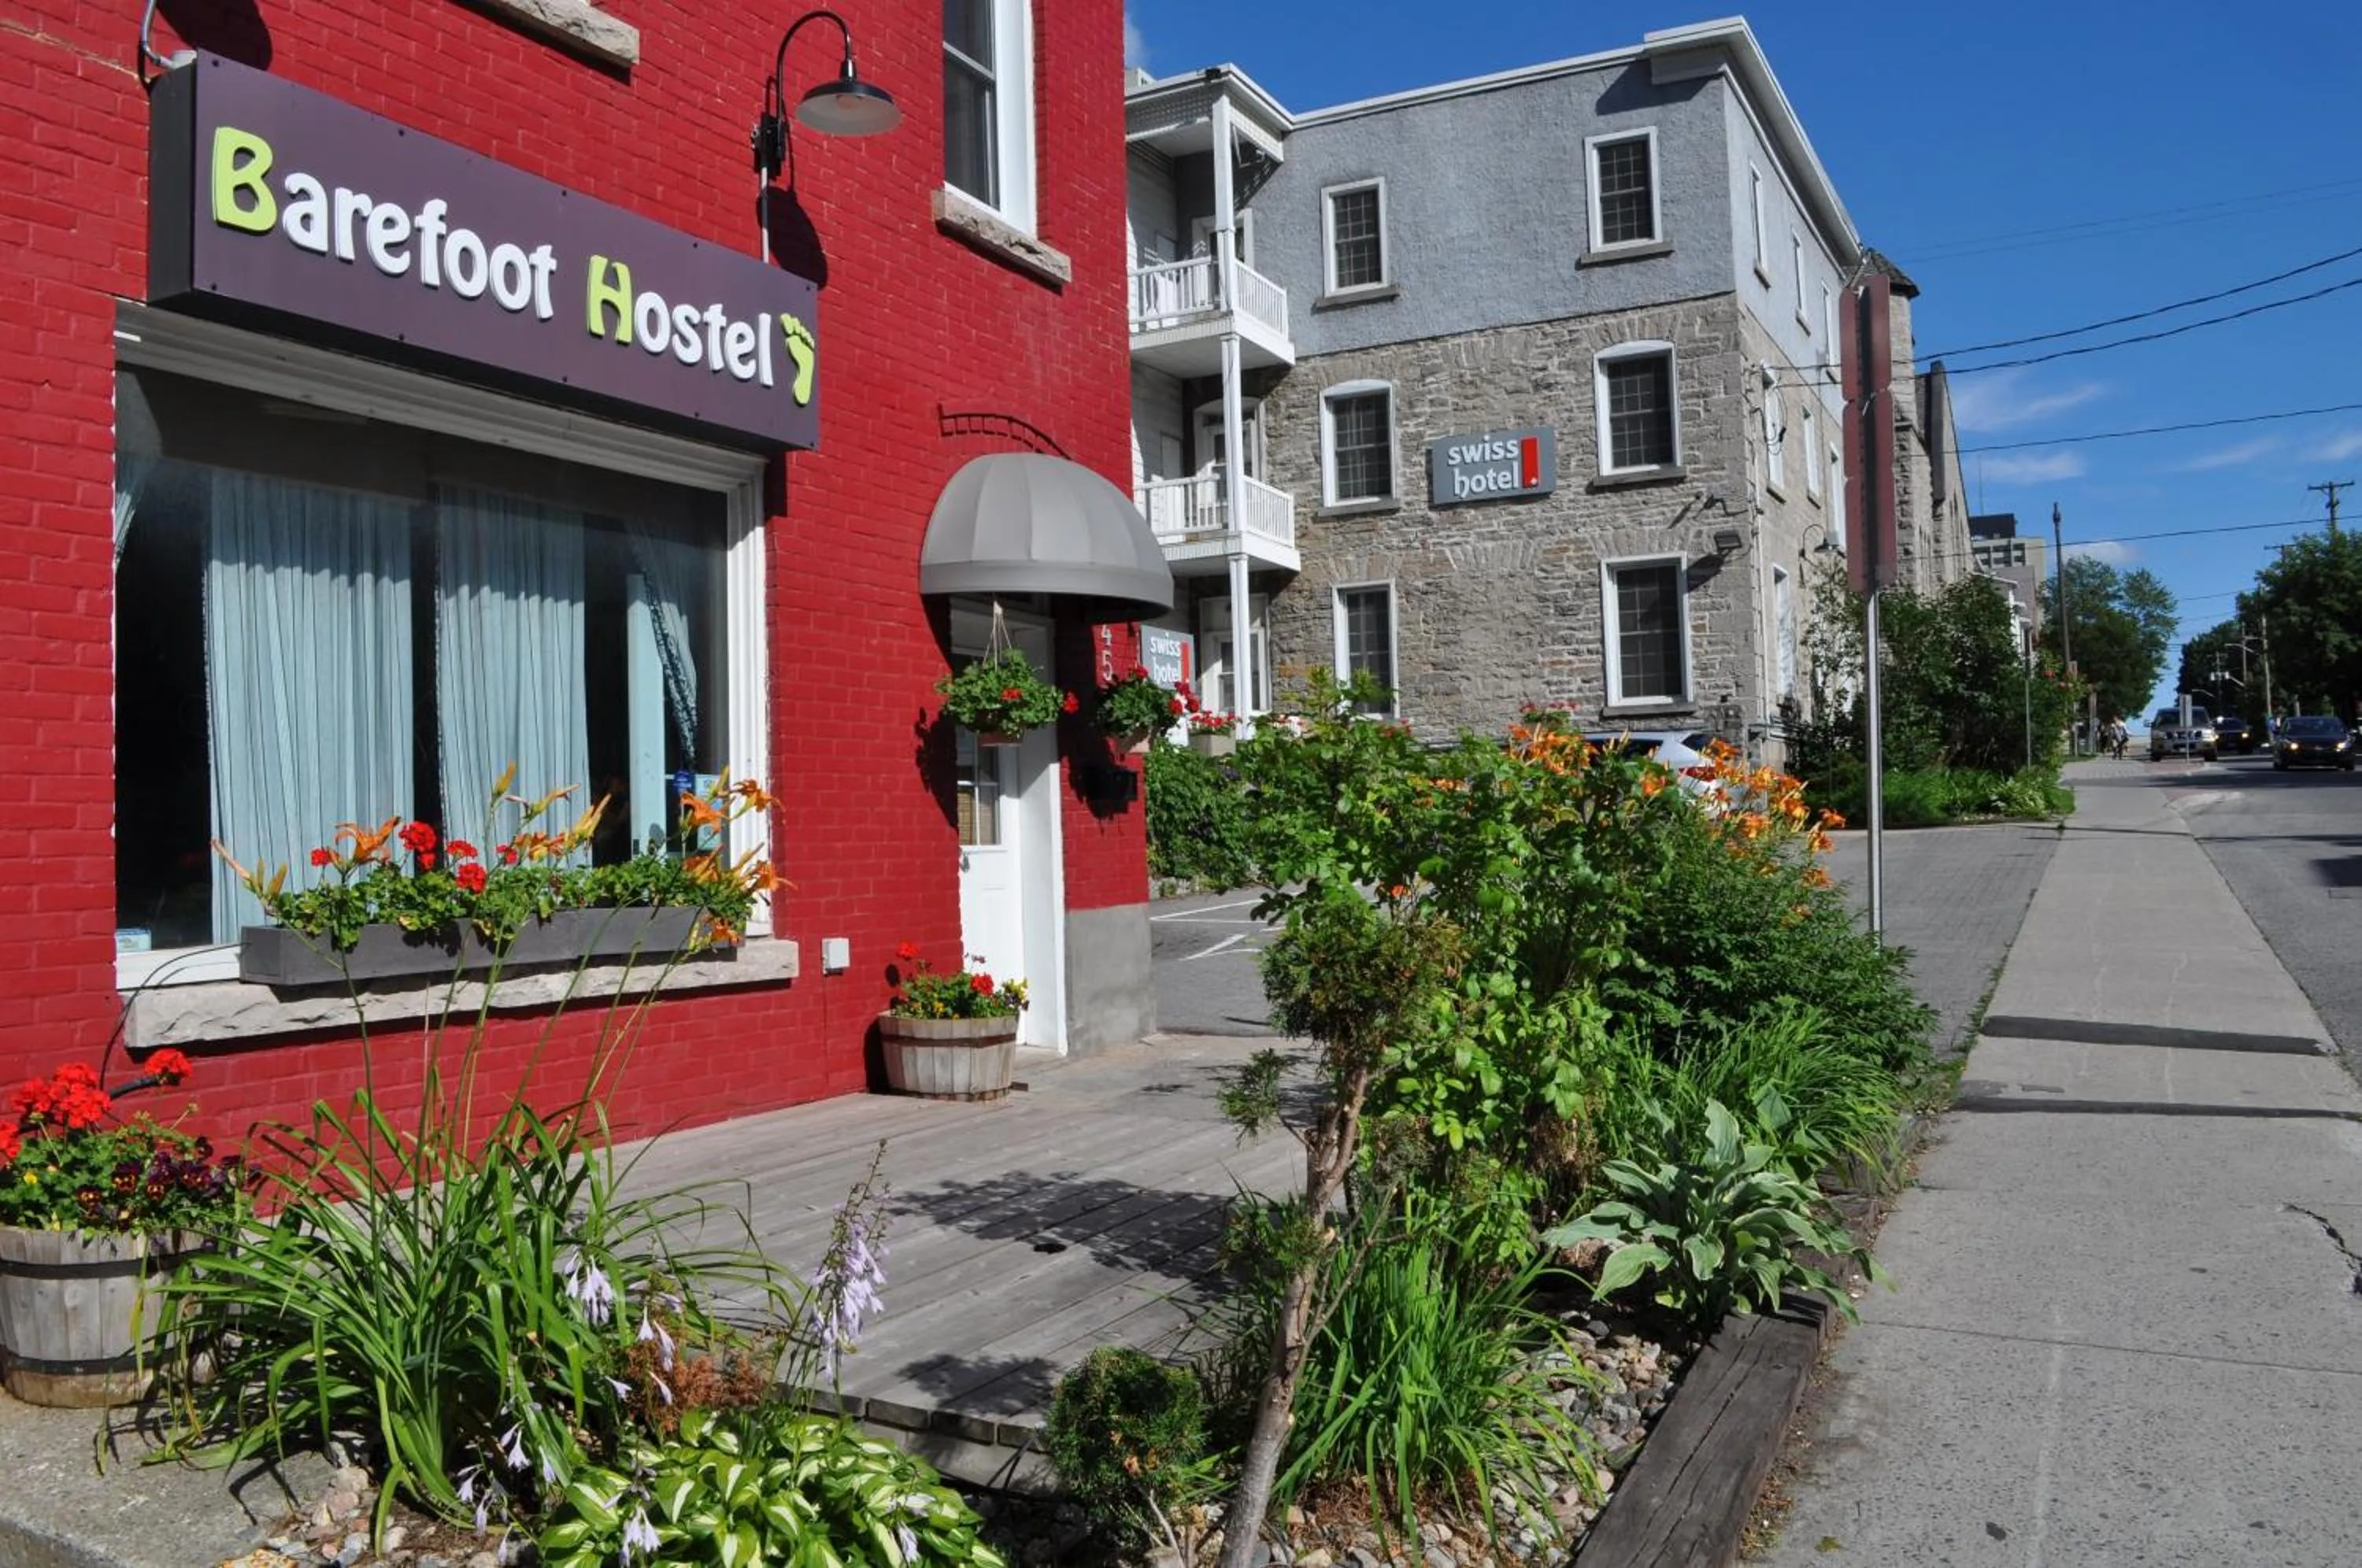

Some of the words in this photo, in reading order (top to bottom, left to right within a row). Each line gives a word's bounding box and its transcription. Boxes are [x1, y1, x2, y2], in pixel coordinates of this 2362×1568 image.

[211, 126, 557, 320] Barefoot
[588, 253, 774, 387] Hostel
[1448, 435, 1520, 465] swiss
[1454, 461, 1520, 498] hotel
[1150, 631, 1181, 656] swiss
[1153, 656, 1181, 685] hotel
